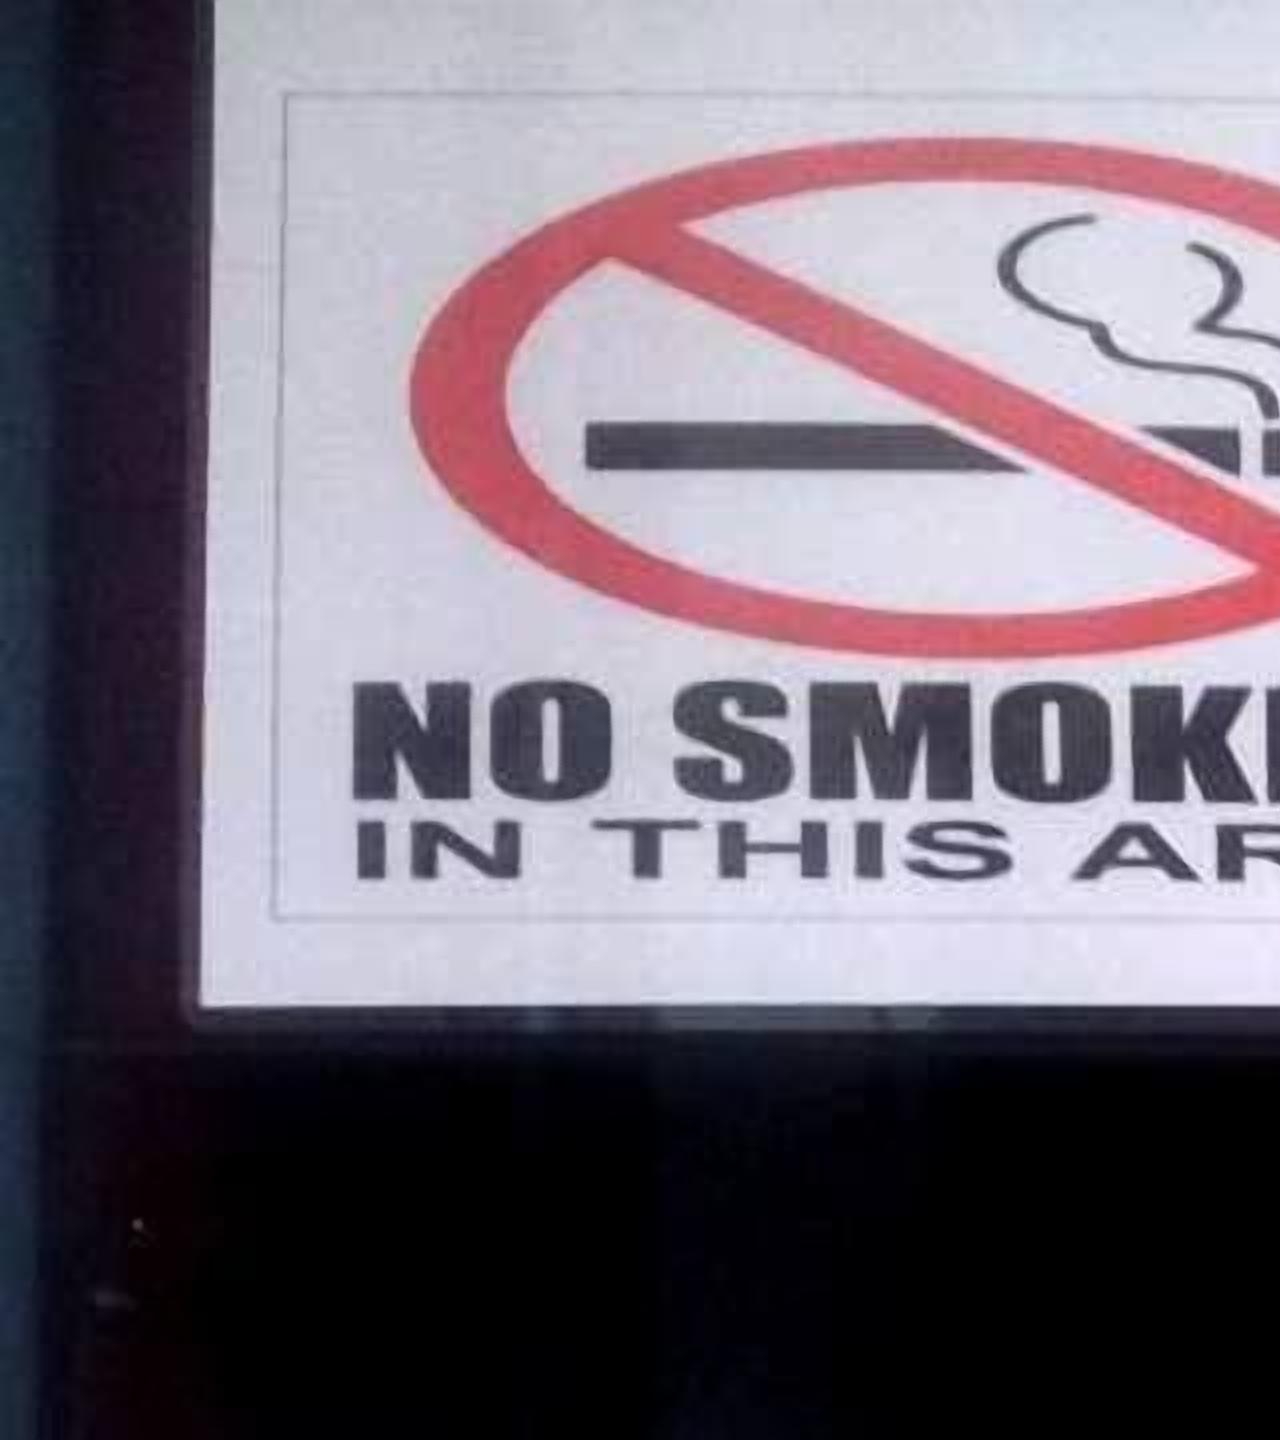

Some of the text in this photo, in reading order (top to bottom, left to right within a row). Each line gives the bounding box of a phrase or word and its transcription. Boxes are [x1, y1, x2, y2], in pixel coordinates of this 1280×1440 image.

[353, 679, 612, 803] NO
[356, 819, 522, 881] IN
[592, 818, 1013, 882] THIS
